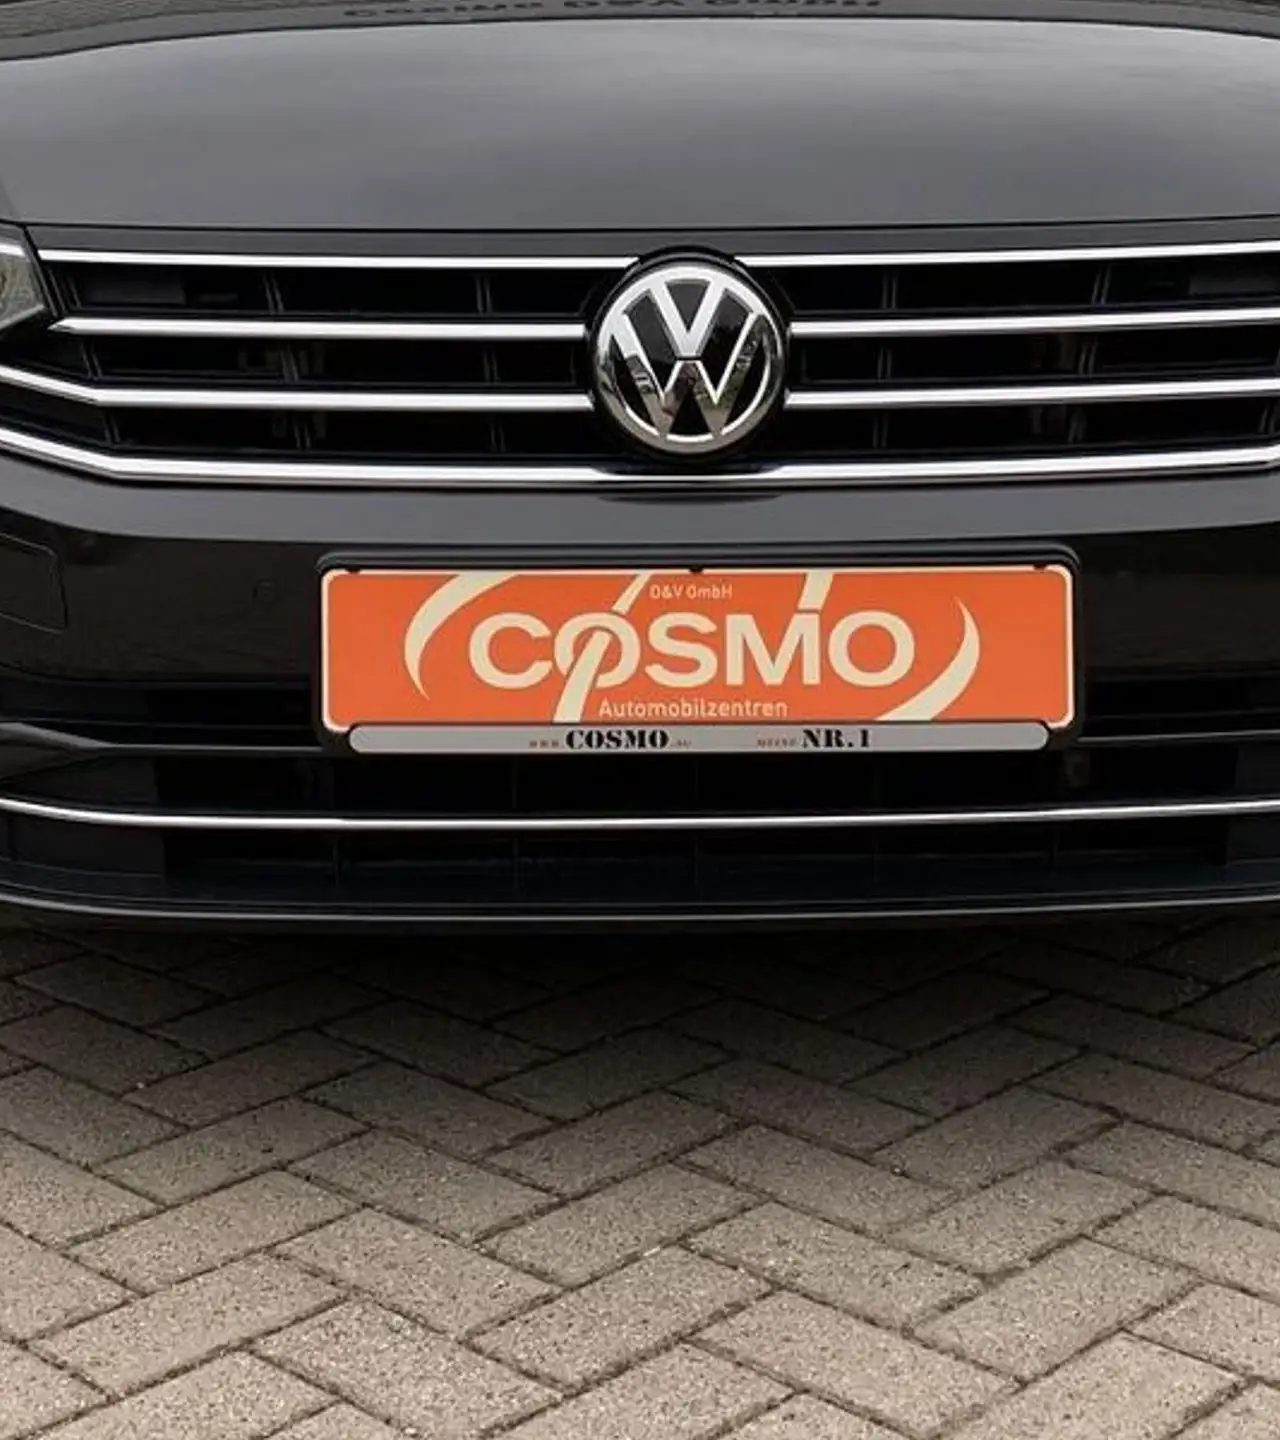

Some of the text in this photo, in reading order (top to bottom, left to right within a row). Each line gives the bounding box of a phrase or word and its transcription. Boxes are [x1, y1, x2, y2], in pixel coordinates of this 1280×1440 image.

[602, 268, 778, 448] VW
[468, 610, 916, 690] COSMO
[598, 697, 789, 719] Automobilzentren
[565, 729, 669, 750] COSMO
